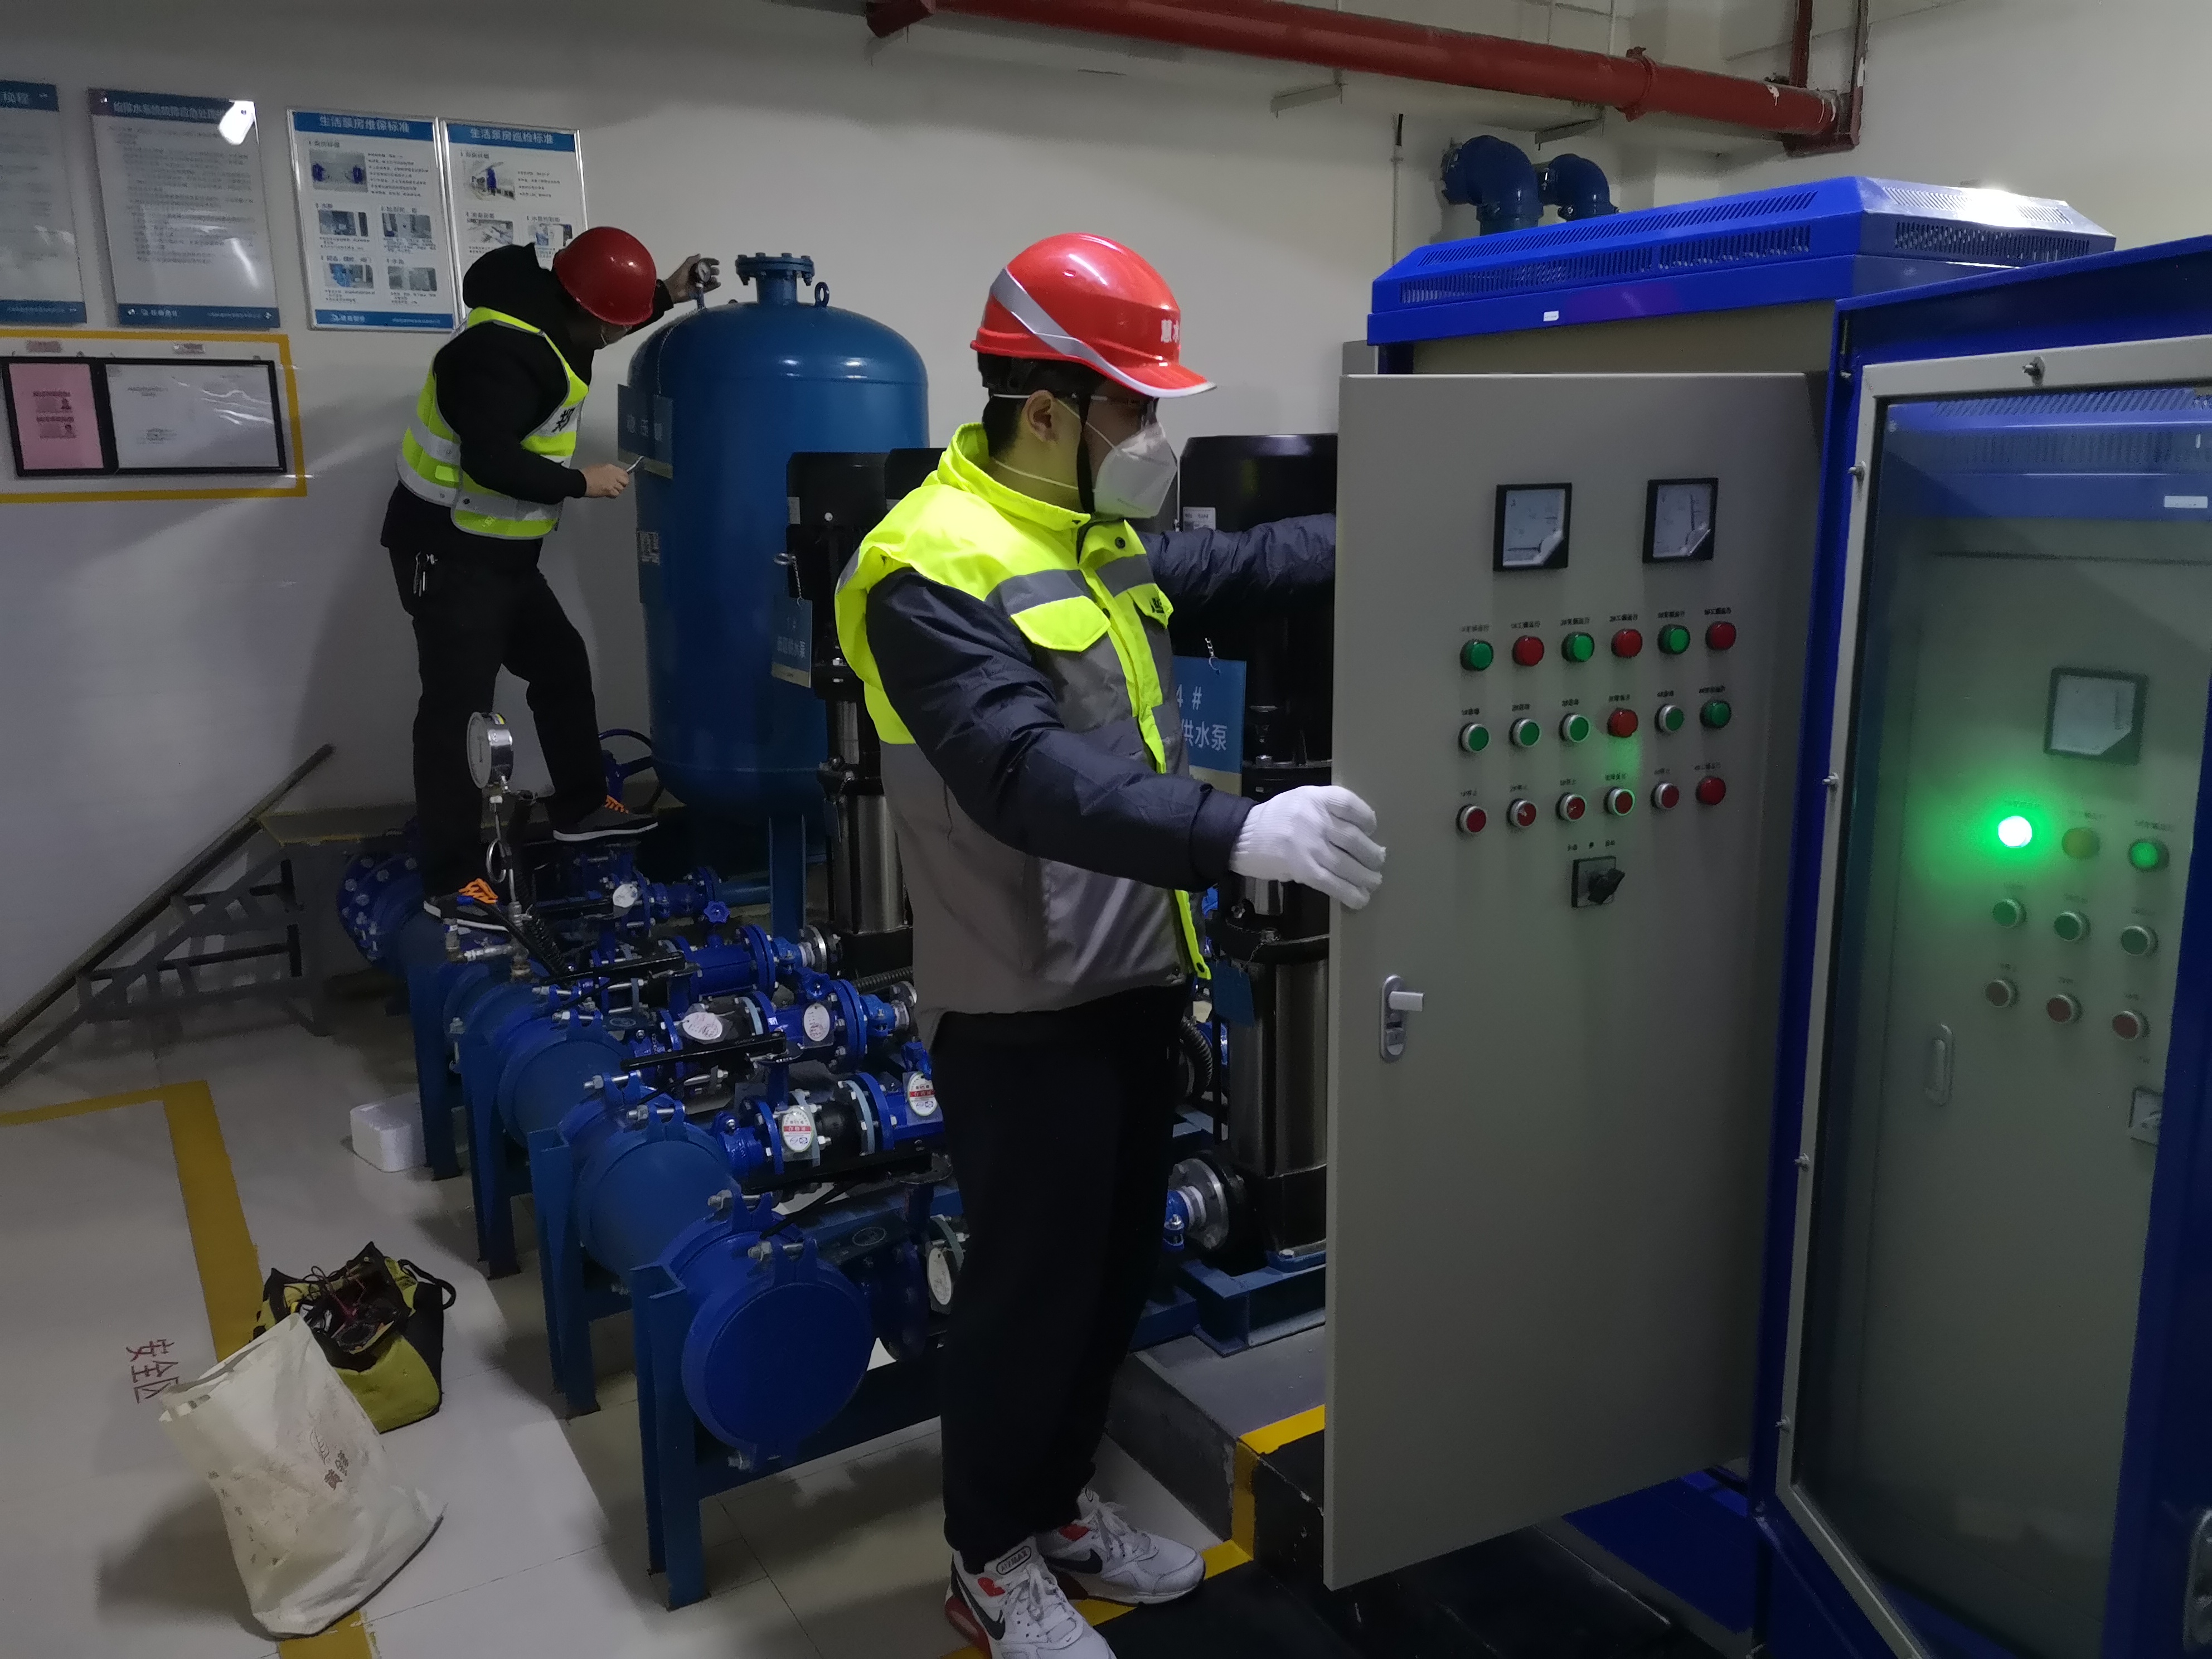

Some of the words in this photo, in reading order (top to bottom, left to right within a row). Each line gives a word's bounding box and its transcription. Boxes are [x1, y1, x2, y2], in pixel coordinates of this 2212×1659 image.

[319, 115, 410, 133] 生活泵房维保标准
[469, 128, 554, 144] 生活泵房巡检标准
[1182, 719, 1228, 751] 供水泵
[126, 1338, 180, 1404] 安全区
